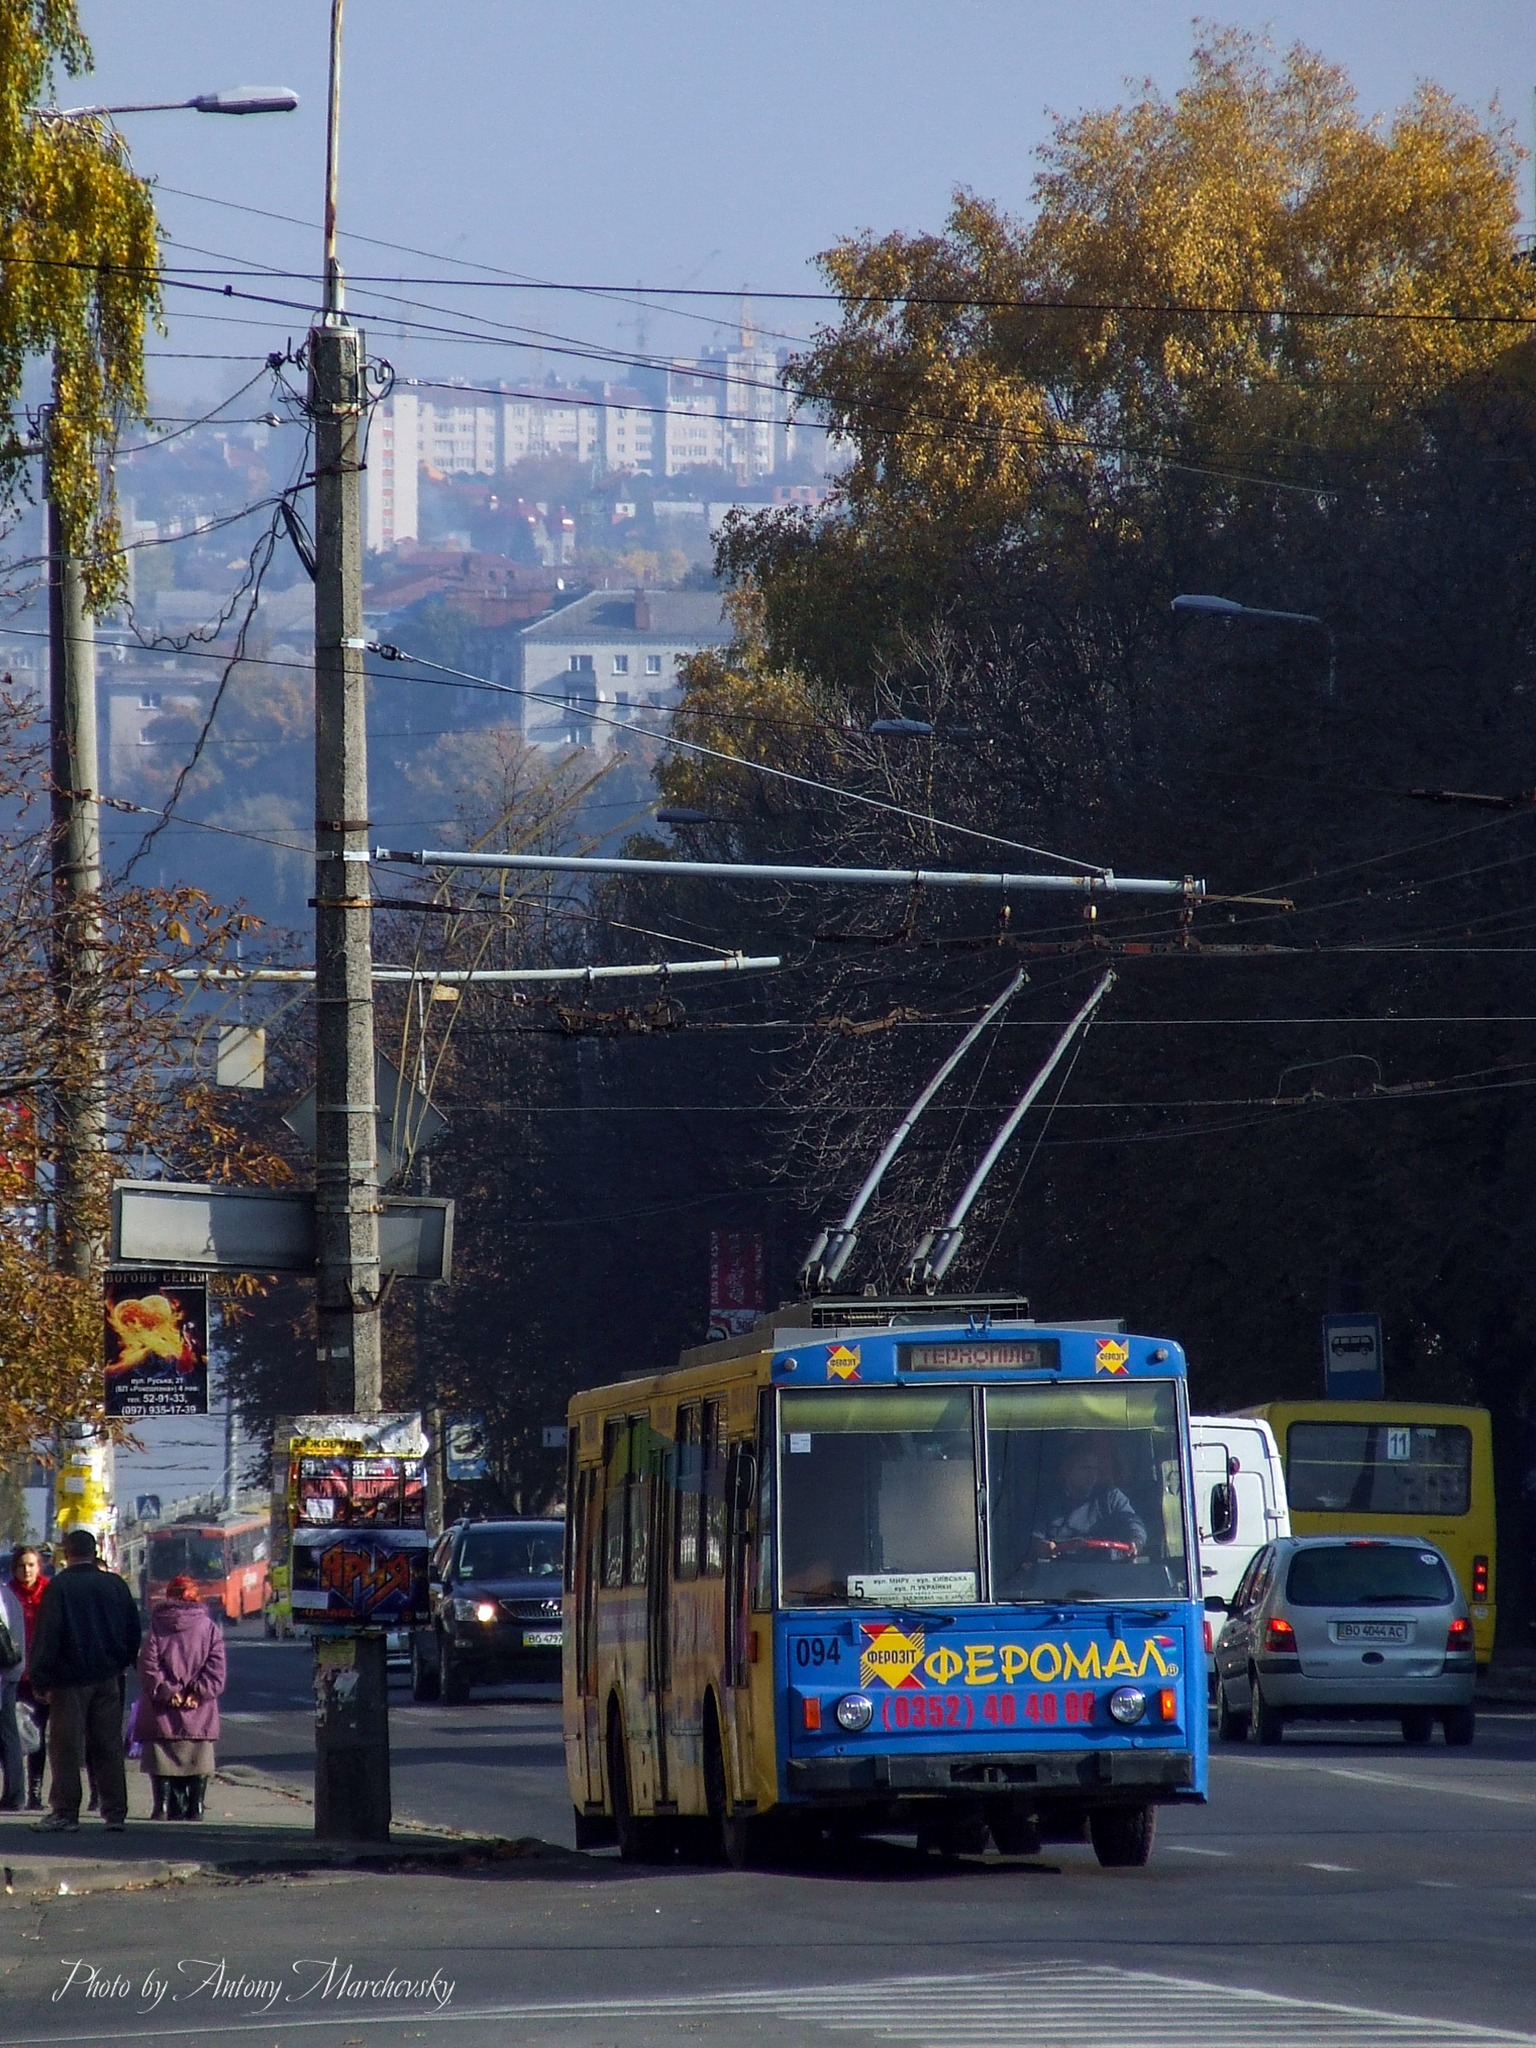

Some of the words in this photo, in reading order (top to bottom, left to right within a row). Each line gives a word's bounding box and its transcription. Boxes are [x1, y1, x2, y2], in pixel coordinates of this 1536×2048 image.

[106, 1273, 156, 1283] ВОГОНЬ
[163, 1273, 205, 1283] СЕРЦЯ
[143, 1394, 188, 1403] 52-91-33,
[122, 1406, 146, 1415] (097)
[149, 1406, 197, 1415] 935-17-39
[1391, 1434, 1407, 1455] 11
[854, 1581, 864, 1599] 5
[1389, 1627, 1403, 1637] AC
[796, 1637, 841, 1667] 094
[867, 1650, 917, 1664] ФЕРОЗІТ
[924, 1639, 1169, 1685] ФЕРОМАЛ
[882, 1694, 974, 1731] (0352)
[983, 1693, 1016, 1725] 40
[1025, 1691, 1058, 1724] 40
